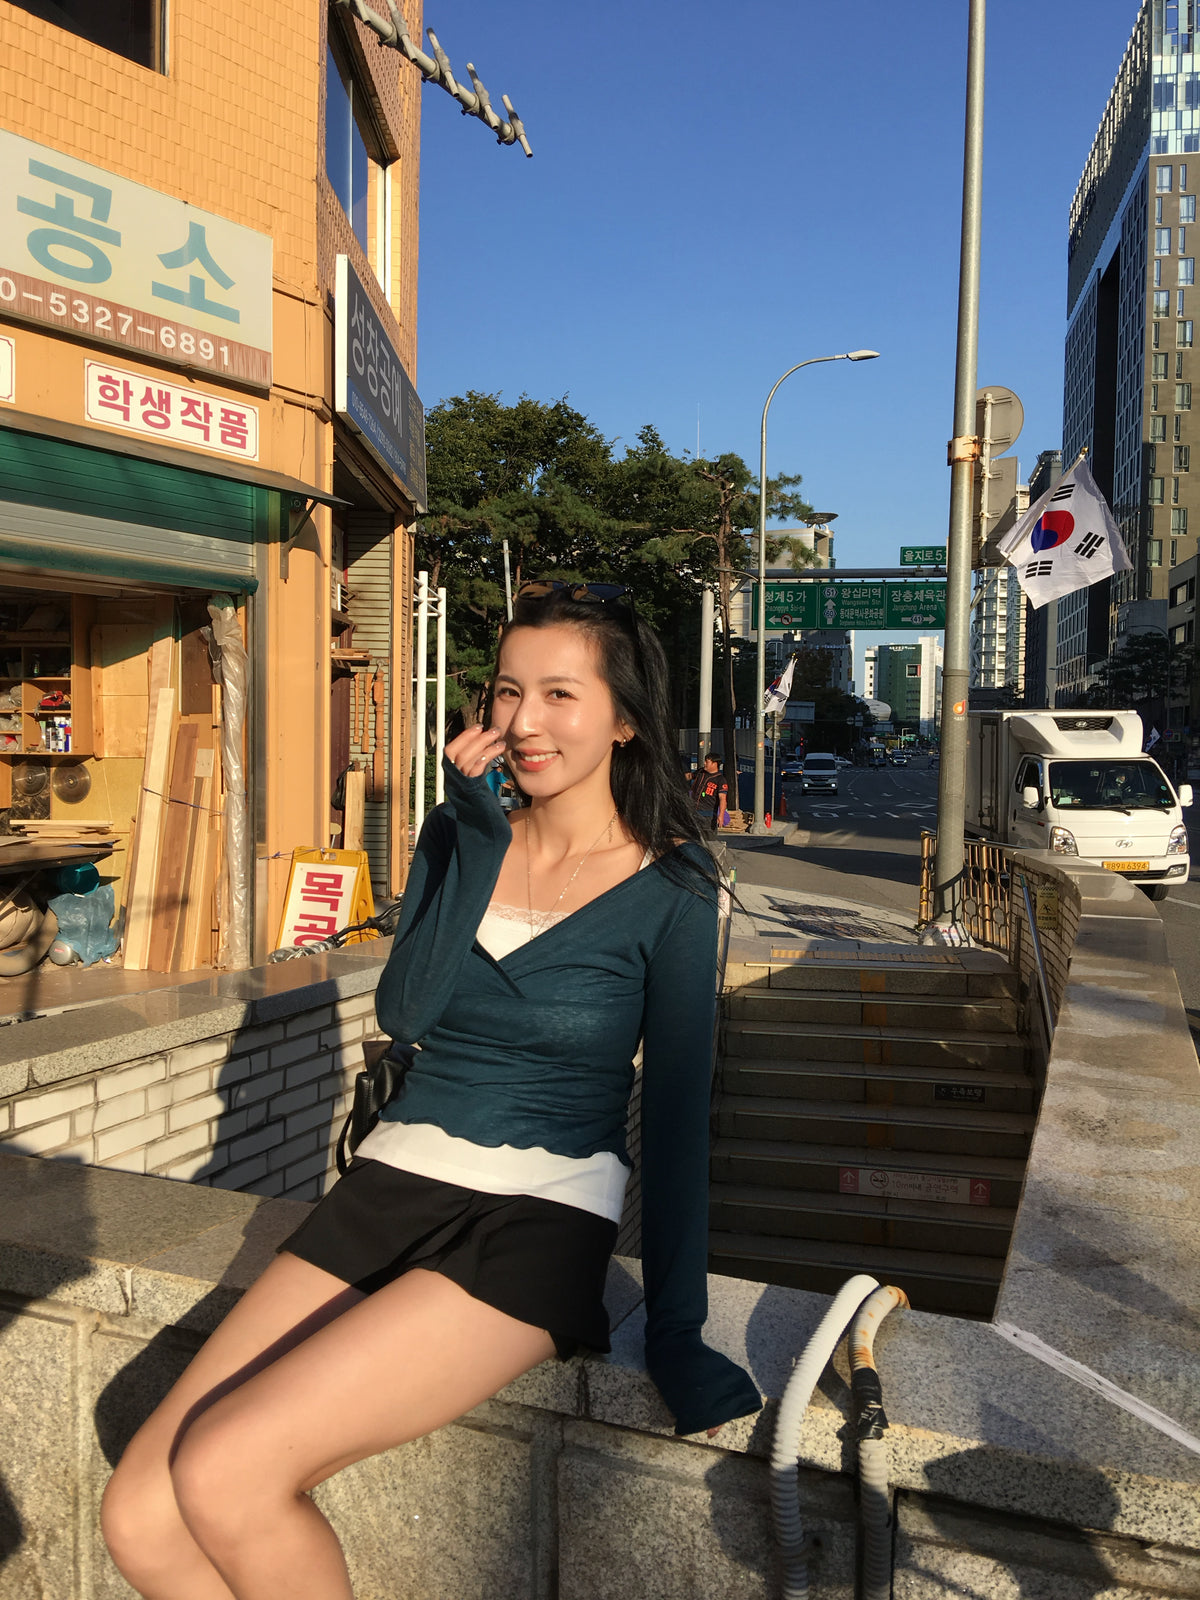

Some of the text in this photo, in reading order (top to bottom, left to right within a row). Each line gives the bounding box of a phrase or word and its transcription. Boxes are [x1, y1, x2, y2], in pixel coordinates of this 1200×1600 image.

[352, 293, 402, 438] 성창공예
[97, 374, 249, 450] 학생작품
[904, 549, 946, 561] 을지로5
[841, 588, 881, 599] 왕십리역
[890, 589, 946, 603] 장충체육관
[919, 603, 937, 611] Arena
